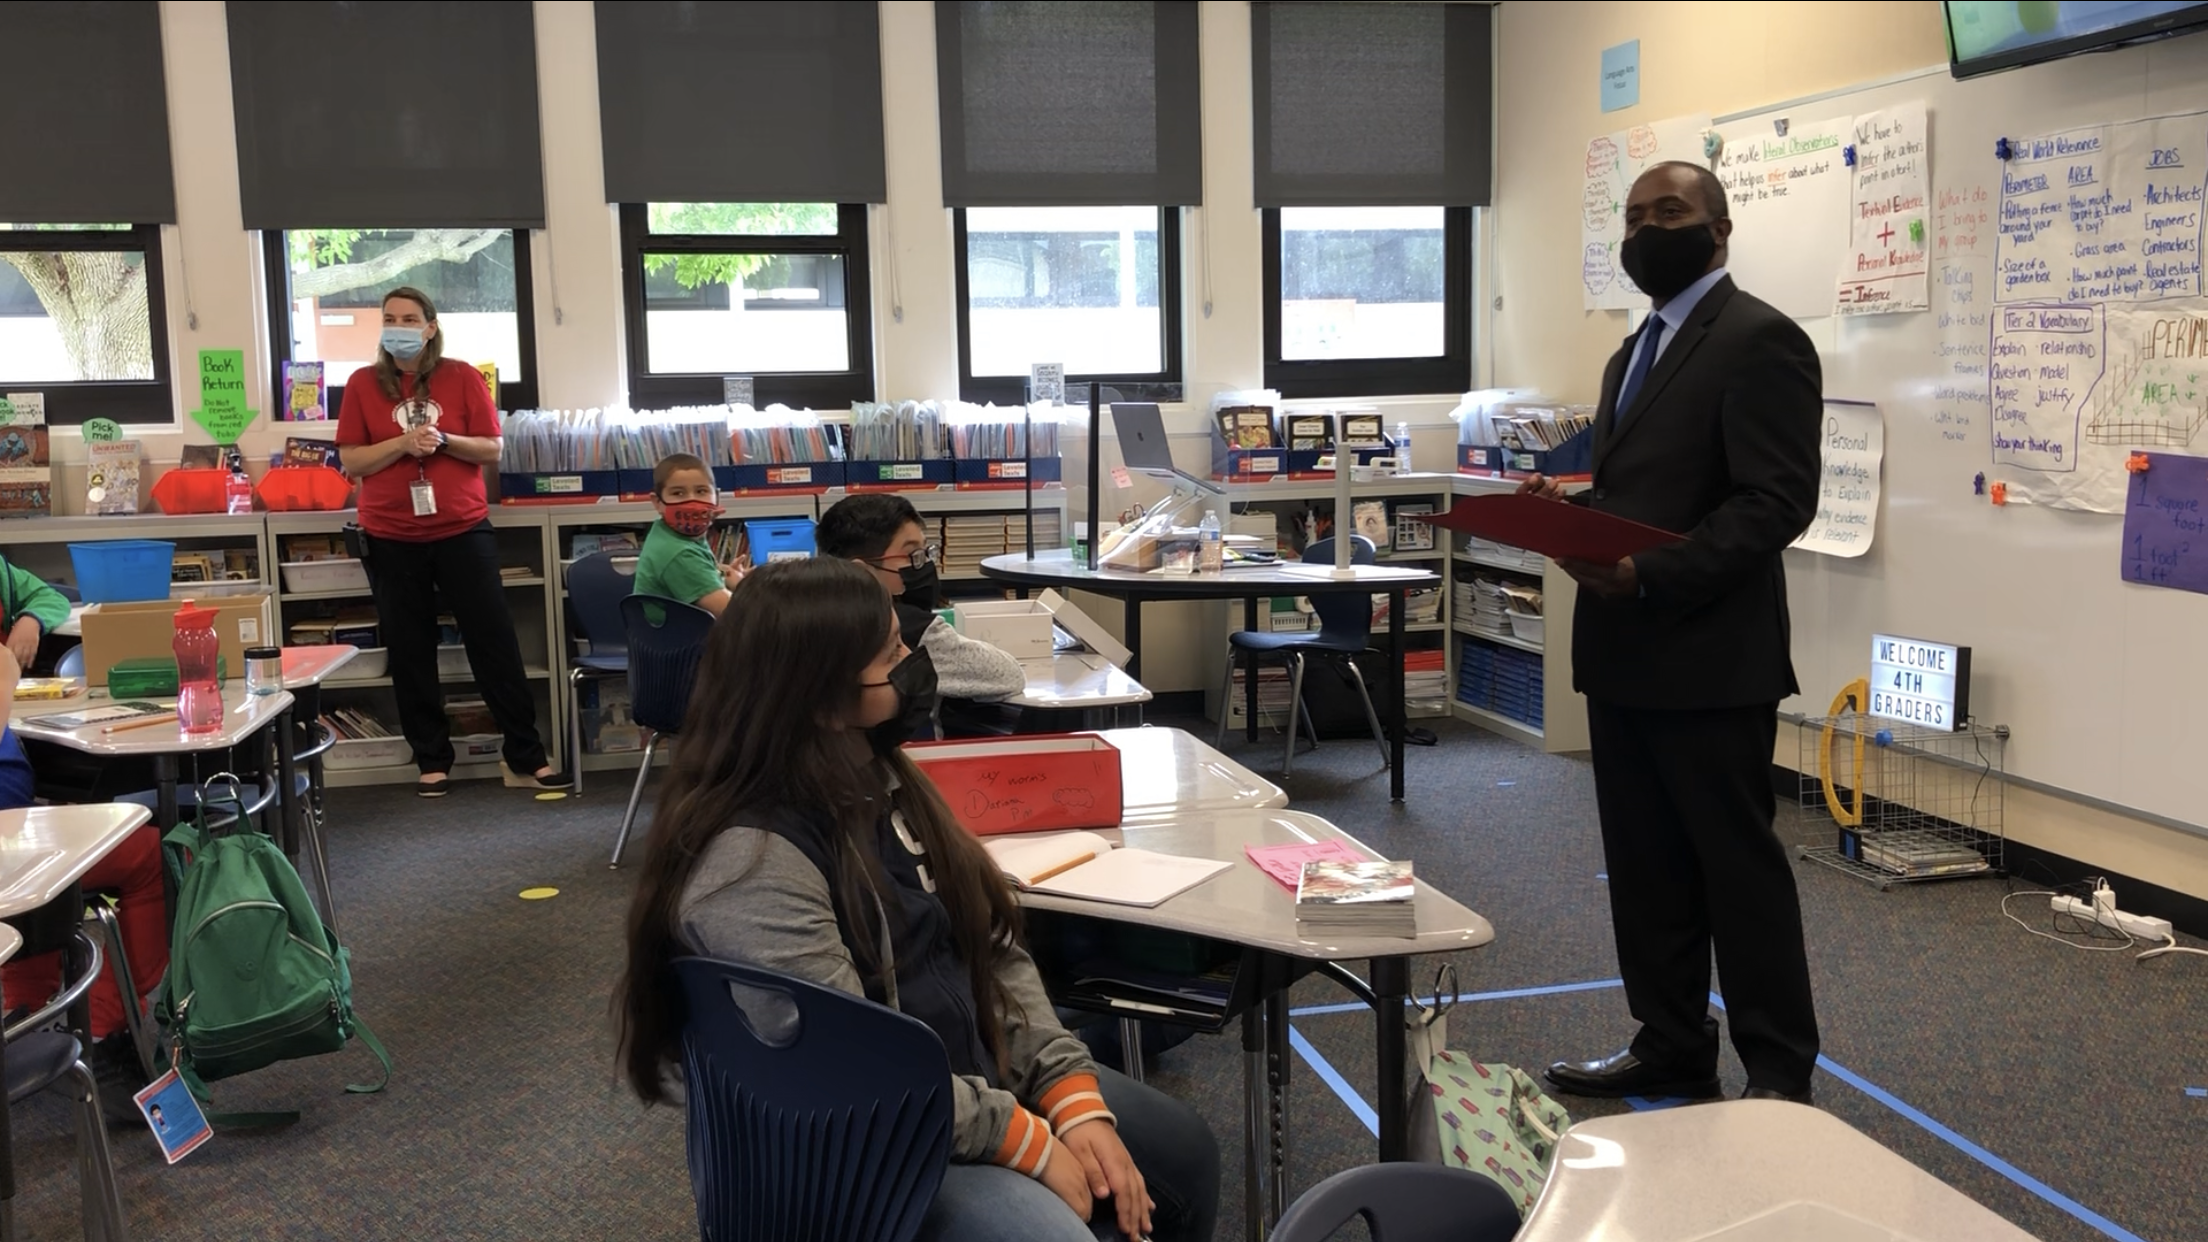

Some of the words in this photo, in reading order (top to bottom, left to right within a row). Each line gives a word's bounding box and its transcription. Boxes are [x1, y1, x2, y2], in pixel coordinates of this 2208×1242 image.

[1856, 121, 1870, 146] We
[1874, 123, 1891, 140] have
[1894, 119, 1902, 134] to
[1736, 145, 1760, 164] make
[1884, 145, 1896, 162] the
[2056, 137, 2101, 155] Relevance
[2149, 148, 2181, 166] JOBS
[1788, 165, 1807, 179] about
[1810, 161, 1830, 175] what
[2068, 165, 2093, 183] AREA
[1733, 191, 1754, 207] might
[1758, 189, 1768, 200] be
[1939, 187, 1968, 210] What
[1972, 186, 1987, 202] do
[2088, 188, 2113, 205] much
[2146, 183, 2202, 205] Architects
[2111, 199, 2132, 214] need
[1937, 214, 1946, 230] I
[1953, 212, 1976, 232] bring
[1978, 209, 1987, 223] to
[2000, 218, 2031, 234] around
[2033, 219, 2053, 234] your
[2144, 212, 2196, 236] Engineers
[2013, 232, 2034, 248] yard
[2075, 242, 2100, 258] Grass
[2103, 242, 2126, 253] area
[2004, 258, 2024, 273] Size
[2025, 257, 2037, 271] of
[2039, 260, 2046, 269] a
[2146, 260, 2166, 279] Real
[2168, 261, 2200, 275] estate
[2072, 267, 2092, 283] How
[2068, 287, 2079, 300] do
[2080, 287, 2086, 299] I
[2088, 284, 2110, 297] need
[2112, 283, 2122, 295] to
[2124, 279, 2143, 298] buy?
[2006, 312, 2022, 328] Tier
[2026, 311, 2035, 328] 2
[2039, 312, 2090, 331] Vocabulary
[1939, 341, 1986, 357] Sentence
[1993, 335, 2026, 357] Explain
[202, 376, 244, 391] Return
[1995, 385, 2019, 403] Agree
[2141, 381, 2181, 406] AREA
[92, 421, 114, 433] Pick
[1827, 417, 1868, 451] Personal
[1823, 482, 1832, 498] to
[1838, 486, 1871, 503] Explain
[2136, 476, 2151, 507] 1
[2155, 496, 2199, 514] square
[2174, 512, 2206, 534] foot
[2129, 534, 2147, 561] 1
[2134, 563, 2147, 581] 1
[1880, 641, 1945, 670] WELCOME
[1893, 671, 1922, 693] 4TH
[1875, 693, 1943, 724] GRADERS
